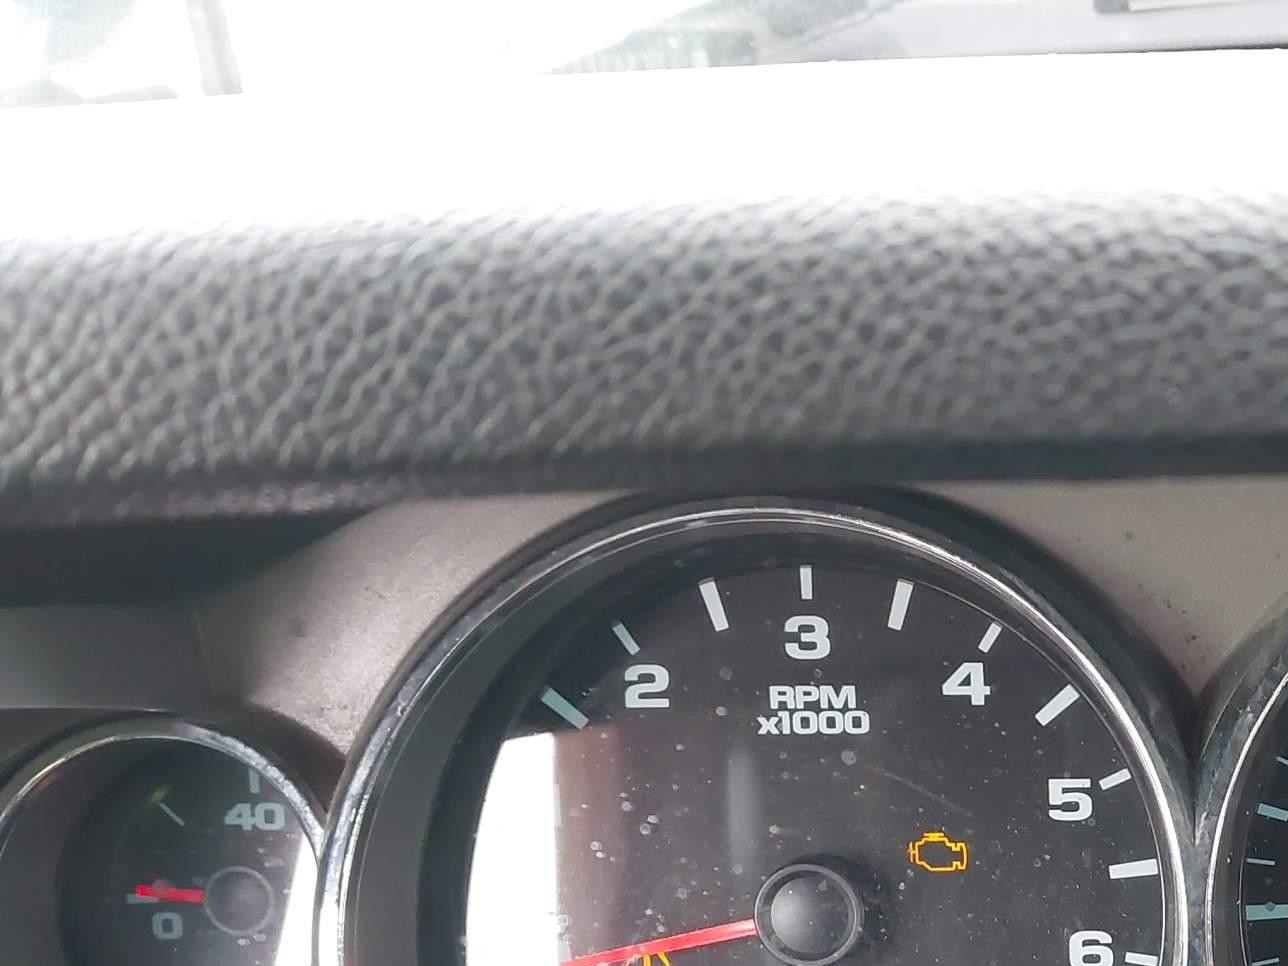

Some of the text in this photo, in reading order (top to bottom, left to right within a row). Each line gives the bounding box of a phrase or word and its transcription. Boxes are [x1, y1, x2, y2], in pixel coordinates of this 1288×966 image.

[784, 616, 831, 660] 3
[624, 664, 670, 708] 2
[769, 685, 857, 709] RPM
[942, 662, 990, 706] 4
[757, 710, 871, 735] x1000
[224, 803, 286, 831] 40
[1048, 778, 1093, 822] 5
[152, 912, 183, 940] 0
